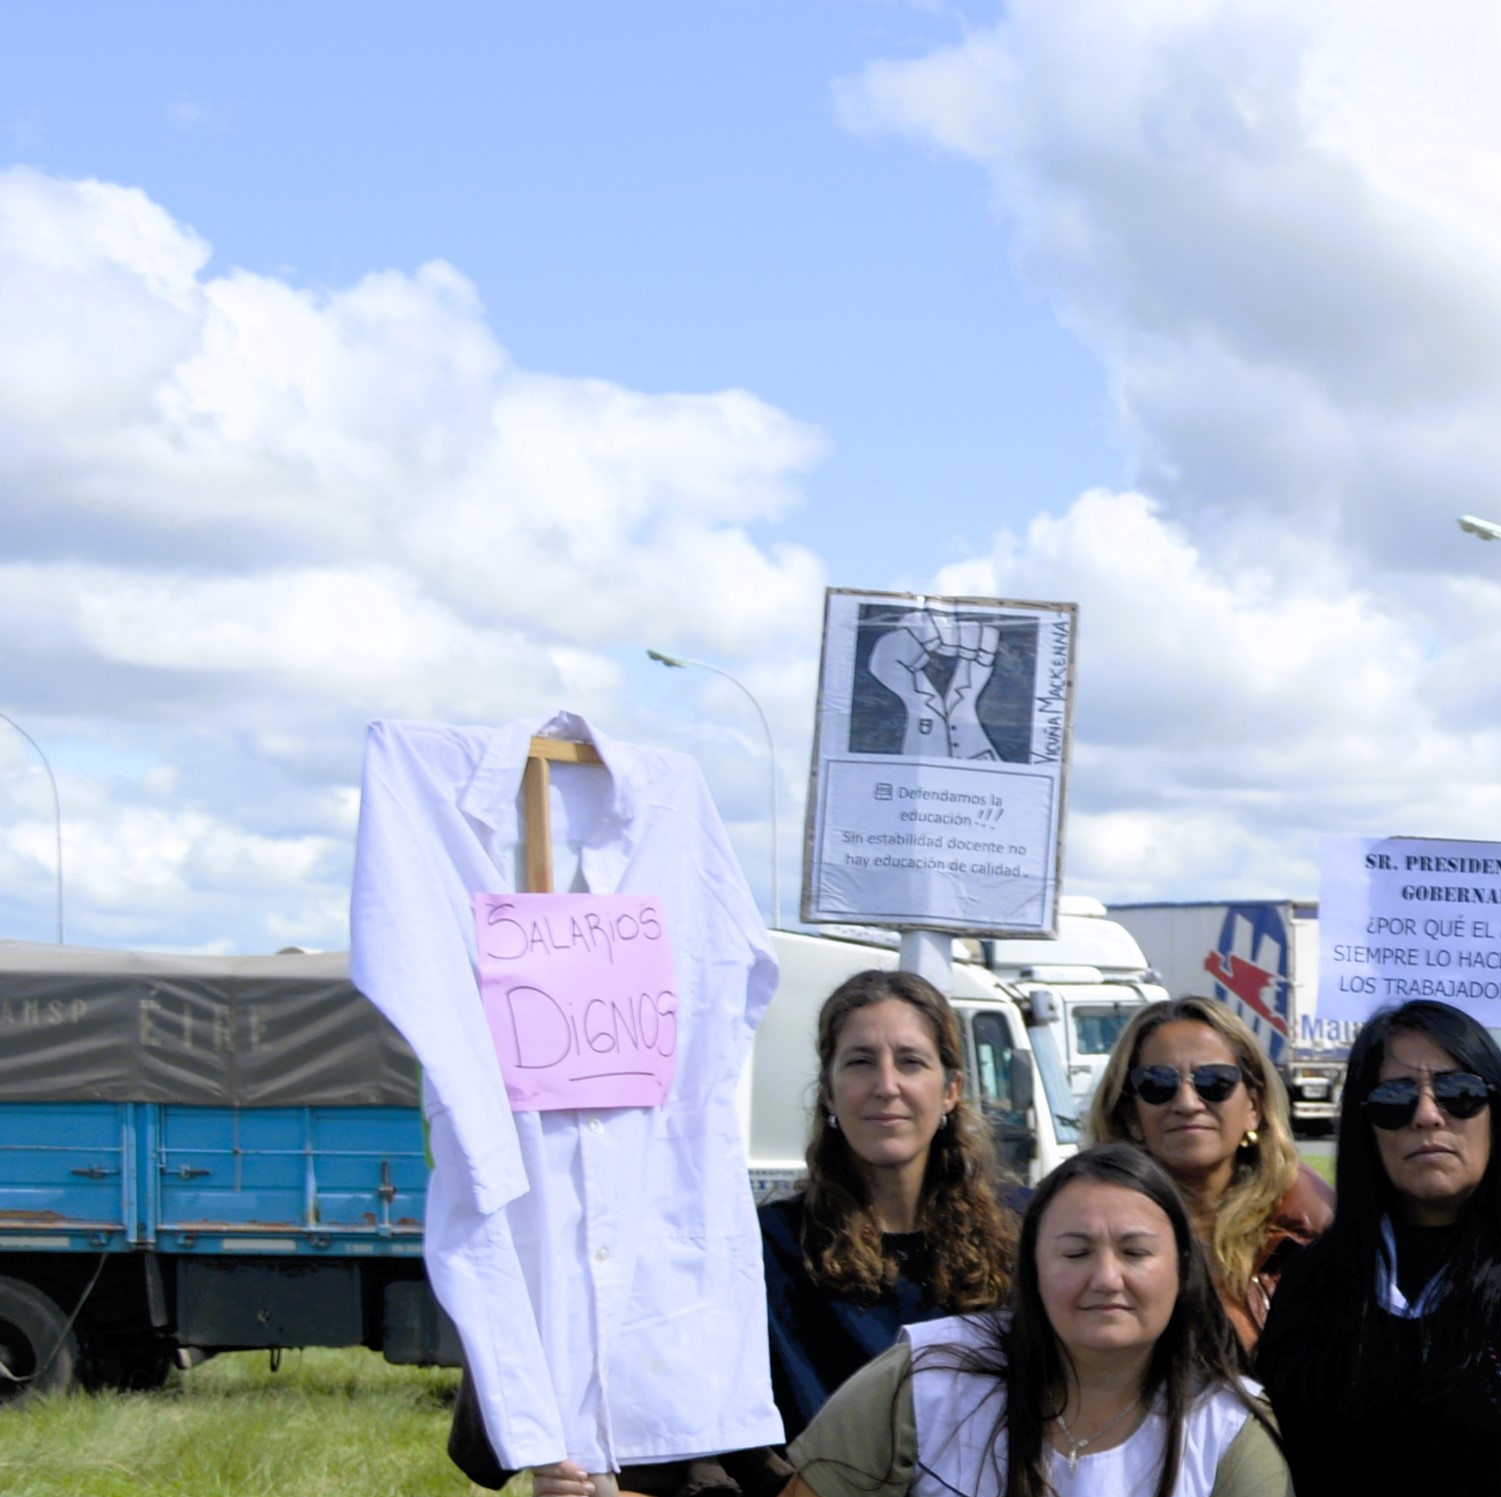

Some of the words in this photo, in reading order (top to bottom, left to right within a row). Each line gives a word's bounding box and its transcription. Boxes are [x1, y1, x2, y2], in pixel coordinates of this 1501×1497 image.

[899, 786, 987, 806] Defendamos
[991, 795, 1003, 807] la
[842, 831, 863, 844] Sin
[868, 833, 943, 848] estabilidad
[947, 837, 1005, 854] docente
[1008, 845, 1027, 856] no
[846, 853, 870, 868] hay
[874, 854, 945, 869] educación
[949, 859, 967, 873] de
[1365, 854, 1398, 871] SR.
[1366, 917, 1416, 936] ¿POR
[1424, 915, 1465, 940] QUÉ
[1473, 921, 1495, 939] EL
[1334, 945, 1419, 966] SIEMPRE
[1427, 950, 1451, 967] LO
[1339, 976, 1376, 994] LOS
